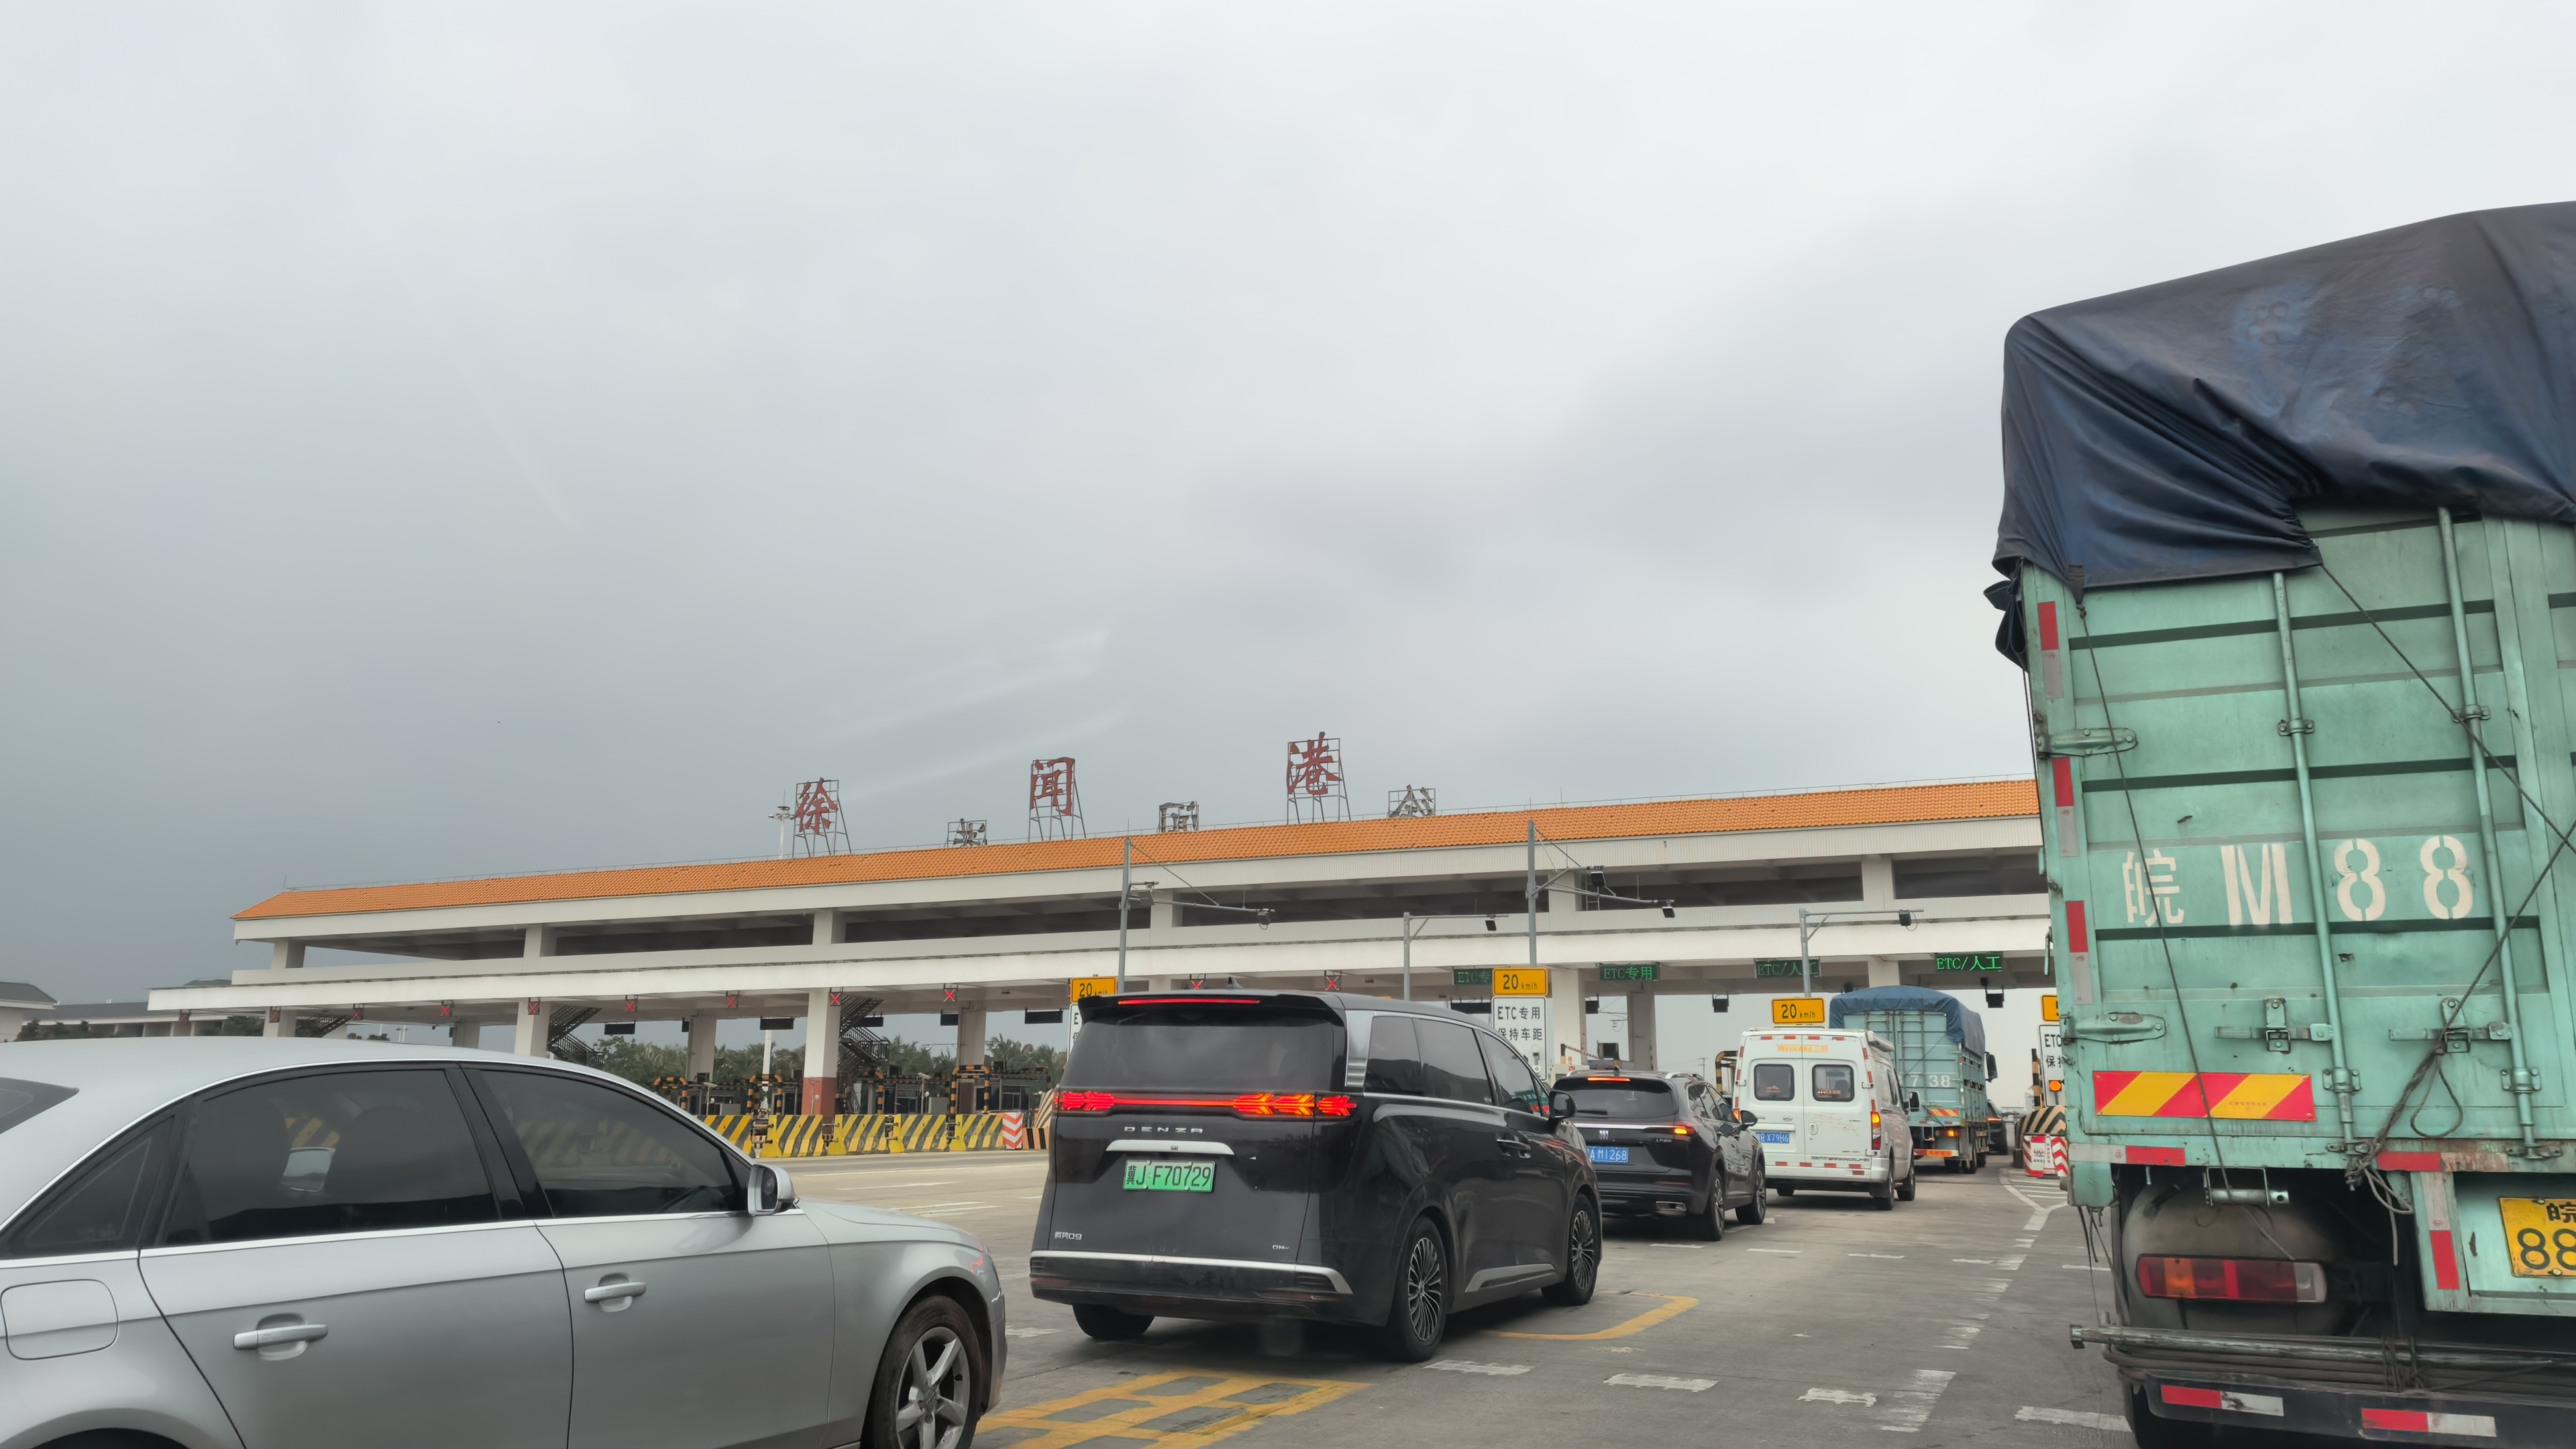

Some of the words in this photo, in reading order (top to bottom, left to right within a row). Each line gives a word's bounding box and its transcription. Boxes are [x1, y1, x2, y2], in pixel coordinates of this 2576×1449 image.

[1937, 955, 2002, 971] ETC/人工
[1604, 967, 1652, 980] ETC专用
[1503, 974, 1518, 989] 20
[1079, 983, 1092, 997] 20
[1498, 1006, 1540, 1020] ETC专用
[1781, 1004, 1796, 1019] 20
[1499, 1028, 1542, 1041] 保持车距
[1587, 1148, 1627, 1161] AM1268
[2517, 1228, 2576, 1271] 88
